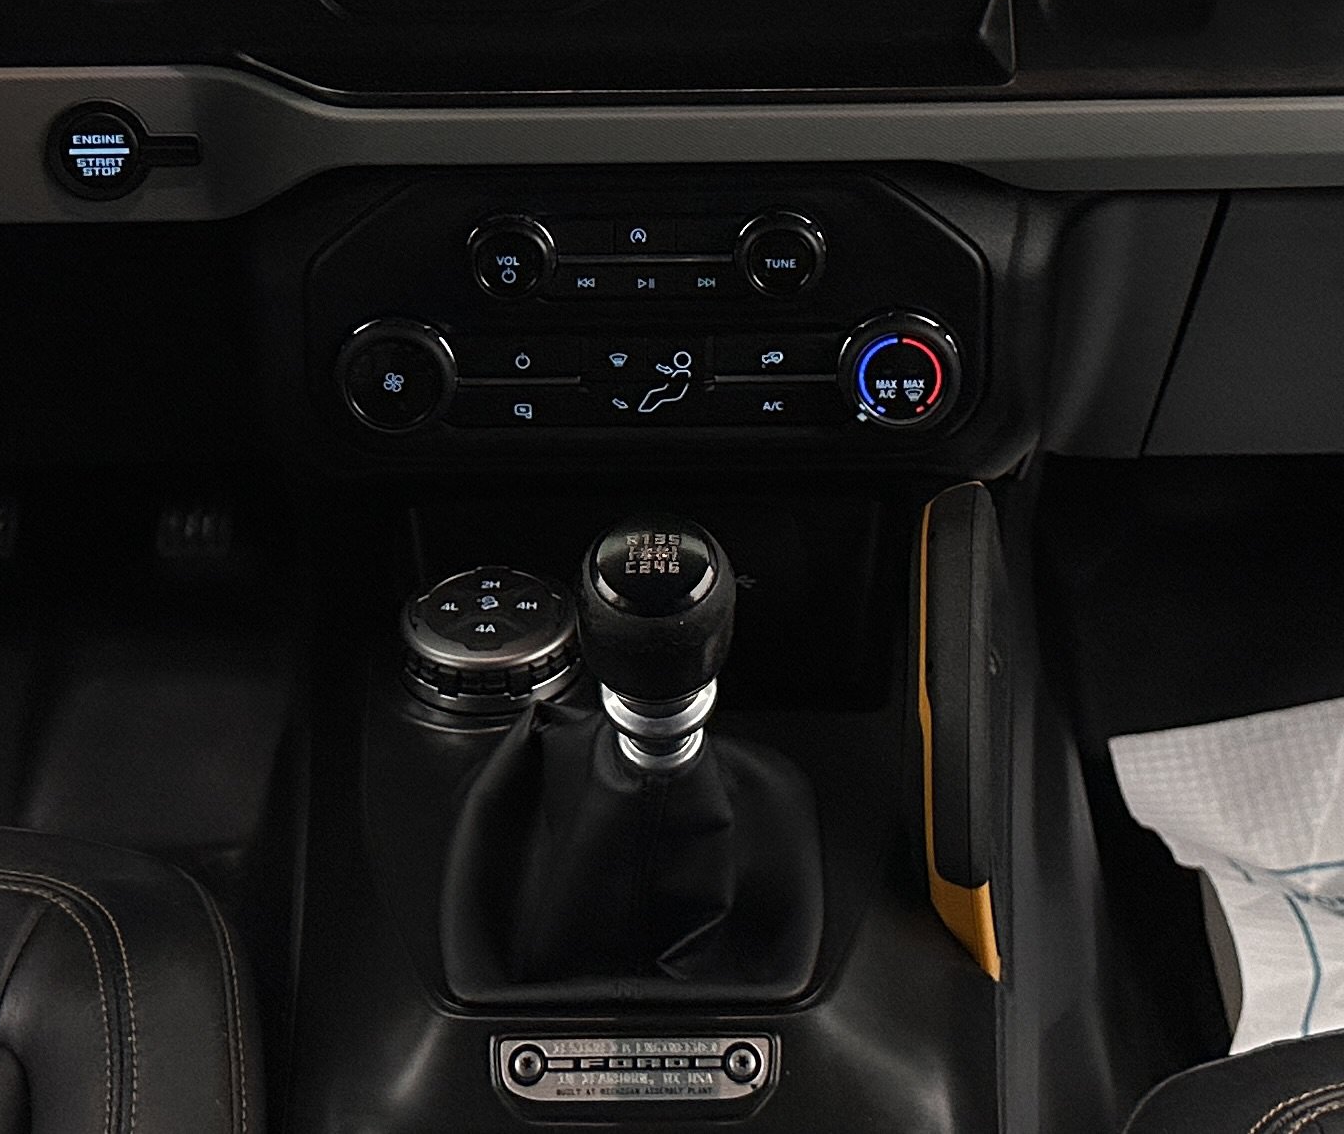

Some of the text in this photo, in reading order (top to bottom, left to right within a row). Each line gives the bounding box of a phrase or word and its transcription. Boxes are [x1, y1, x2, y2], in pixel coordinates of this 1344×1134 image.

[72, 134, 125, 144] ENGINE
[76, 157, 125, 167] START
[83, 167, 121, 177] STOP
[496, 256, 520, 266] VOL
[765, 258, 797, 269] TUNE
[875, 379, 898, 389] MAX
[903, 379, 925, 389] MAX
[878, 389, 897, 399] A/C
[762, 401, 784, 412] A/C
[480, 580, 501, 589] 2H
[440, 602, 459, 611] 4L
[516, 601, 538, 611] 4H
[474, 624, 496, 633] 4A
[580, 1057, 690, 1069] FORD
